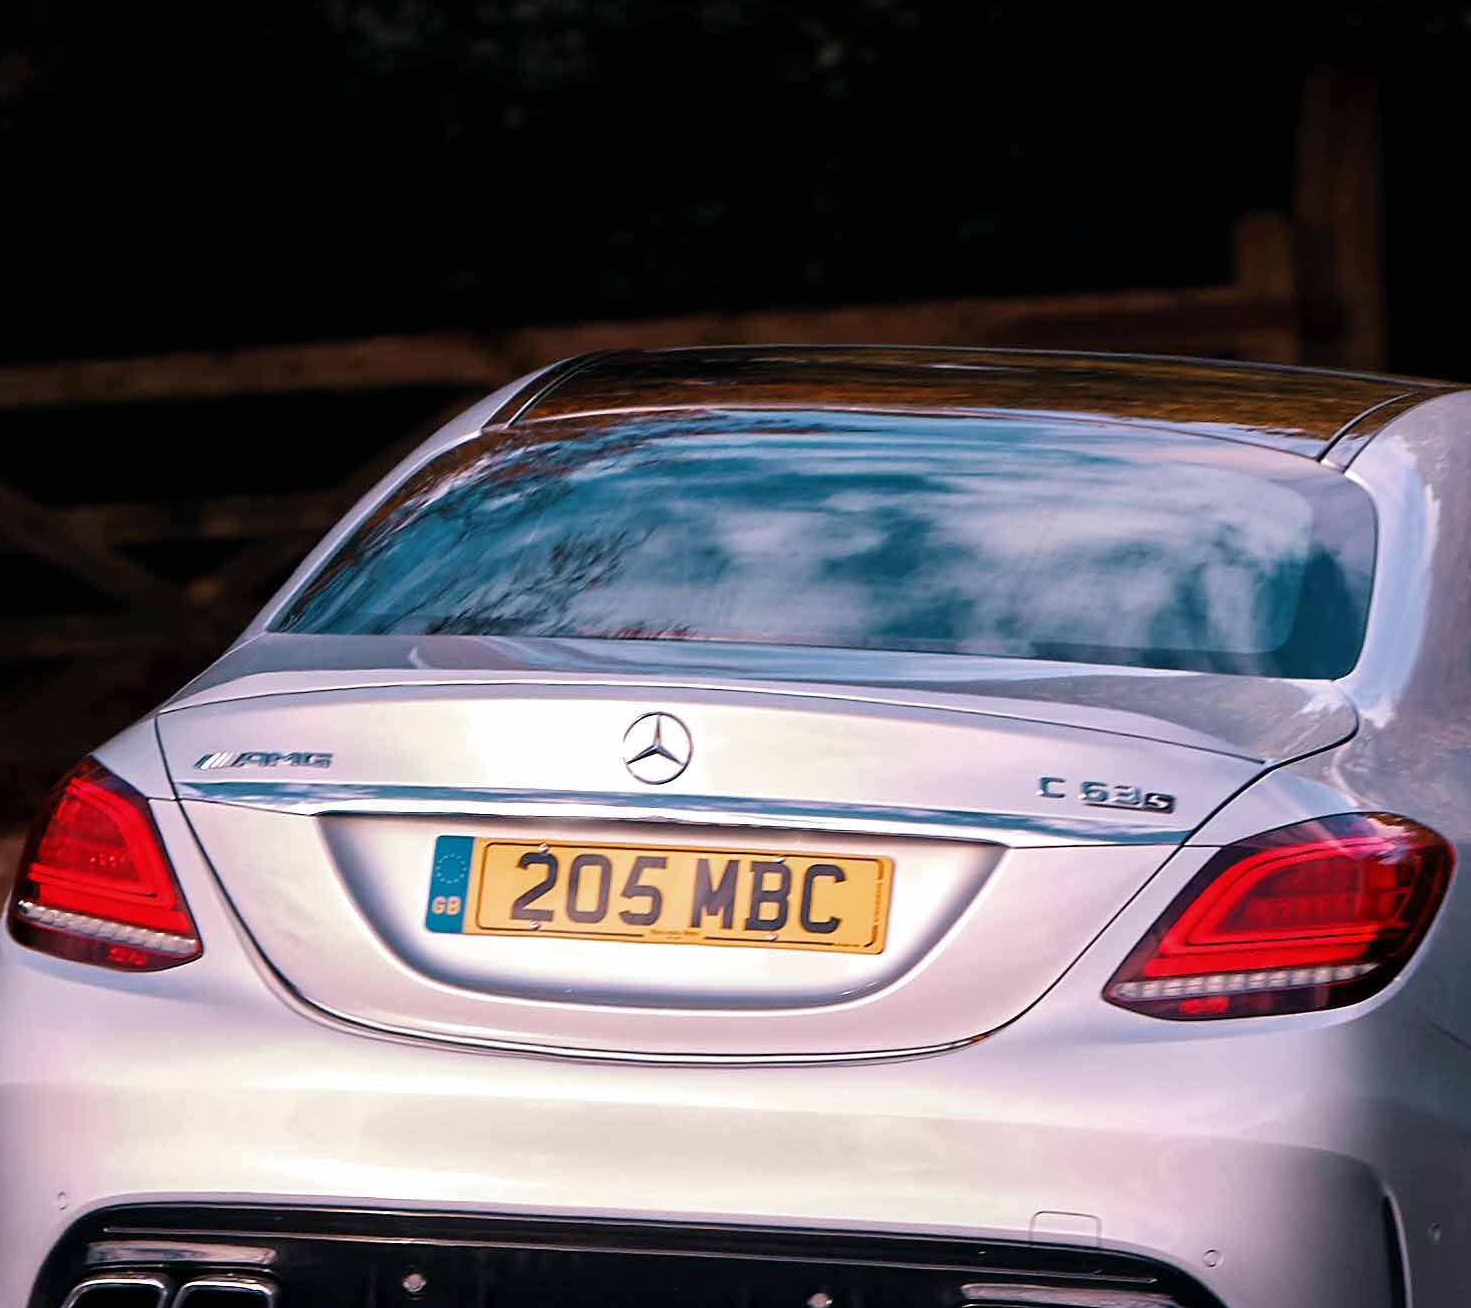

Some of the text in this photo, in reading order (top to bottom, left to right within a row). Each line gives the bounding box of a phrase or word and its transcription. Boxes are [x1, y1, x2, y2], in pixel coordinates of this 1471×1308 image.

[231, 751, 333, 769] AMG
[1038, 776, 1067, 799] C
[510, 852, 667, 925] 205
[690, 858, 846, 935] MBC
[432, 896, 461, 915] GB
